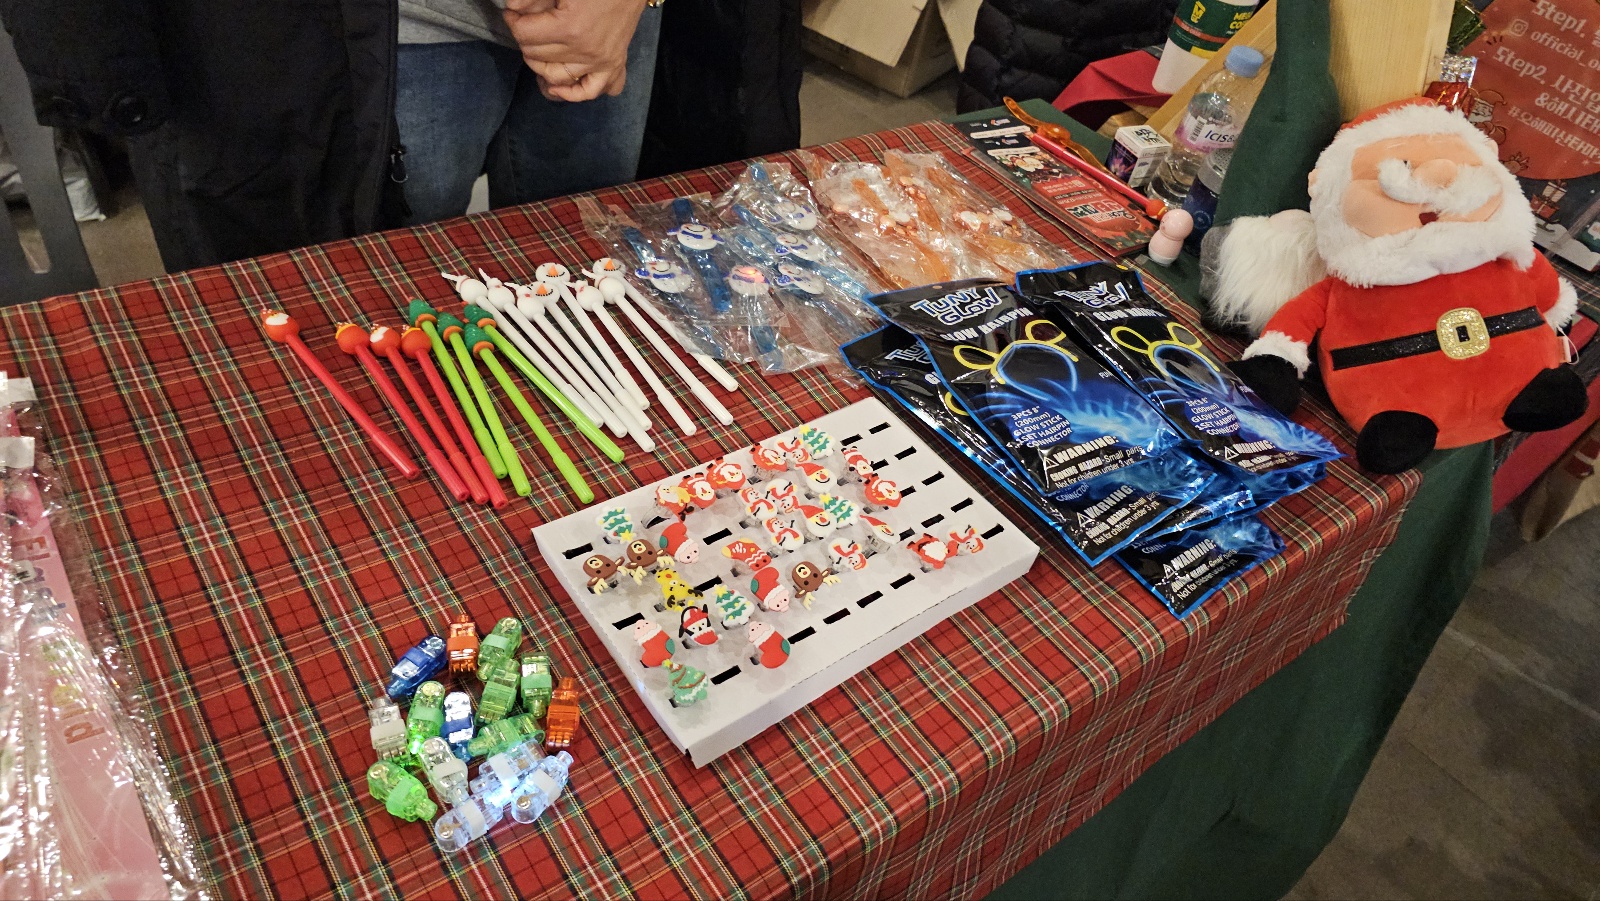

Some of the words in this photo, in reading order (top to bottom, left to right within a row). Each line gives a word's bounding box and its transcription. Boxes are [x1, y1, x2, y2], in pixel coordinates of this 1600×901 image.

[1532, 0, 1587, 38] Step1.
[1492, 46, 1547, 85] Step2.
[938, 286, 1002, 326] GLOW
[978, 307, 1033, 335] HAIRPIN
[1011, 408, 1034, 420] 3PCS
[1013, 423, 1039, 437] GLOW
[1039, 414, 1063, 428] STICK
[1014, 412, 1051, 428] (200mm)
[1191, 411, 1214, 423] GLOW
[1213, 406, 1232, 419] STICK
[1026, 428, 1073, 448] CONNECTOR
[1038, 420, 1071, 438] HAIRPIN
[1053, 435, 1119, 464] WARNING:
[1055, 479, 1067, 489] Not
[1067, 477, 1077, 486] for
[1077, 469, 1103, 483] children
[1101, 464, 1120, 475] under
[1118, 461, 1126, 470] 3
[1092, 535, 1104, 546] Not
[1111, 517, 1135, 536] children
[1170, 539, 1217, 571] WARNING:
[1176, 592, 1189, 601] Not
[1188, 583, 1198, 592] for
